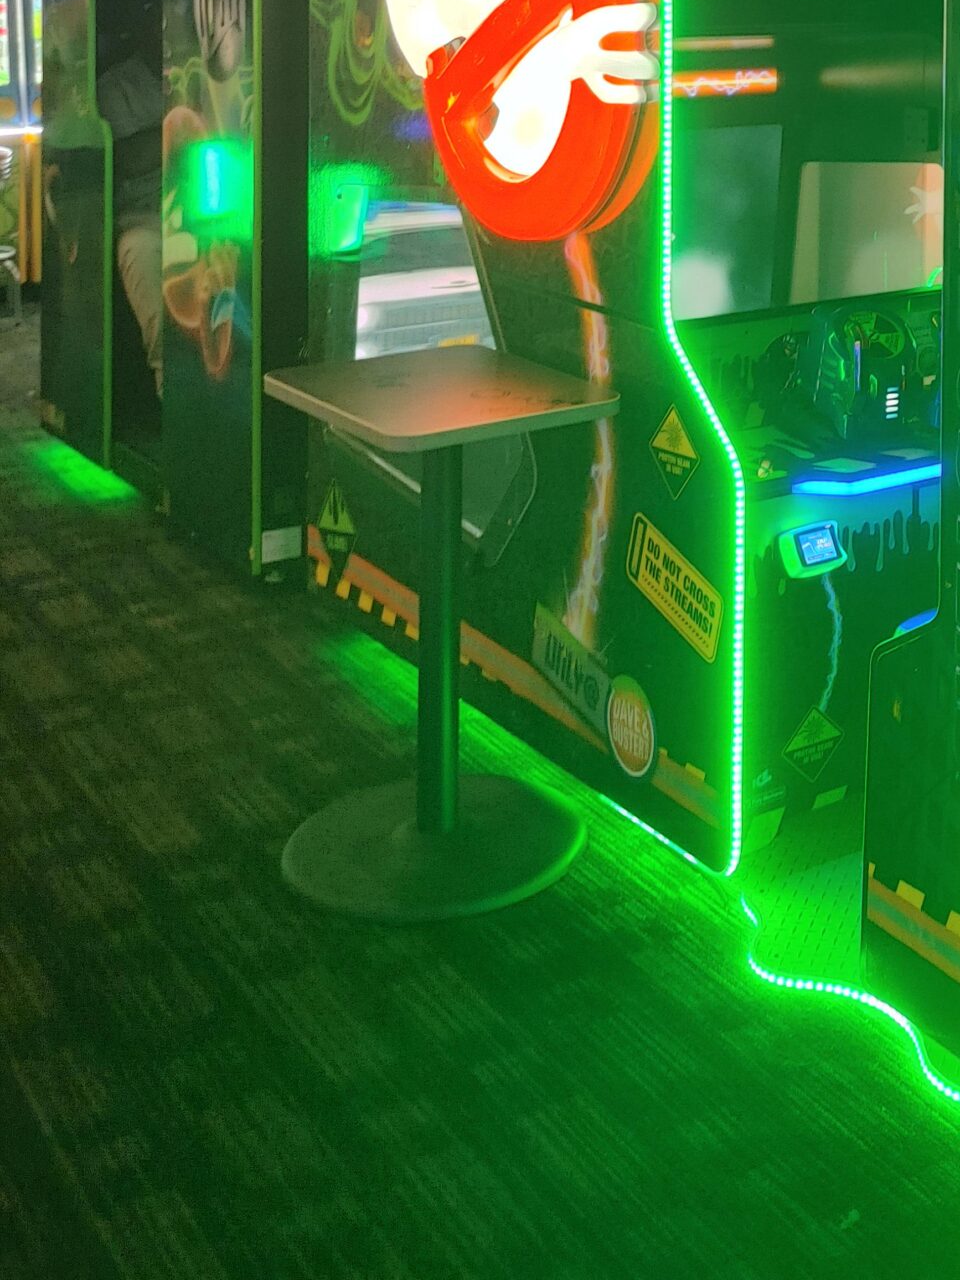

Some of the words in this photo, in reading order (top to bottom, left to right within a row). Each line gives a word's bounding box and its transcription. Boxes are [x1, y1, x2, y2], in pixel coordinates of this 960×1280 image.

[645, 554, 662, 585] THE
[663, 575, 713, 638] STREAMS!
[647, 537, 660, 561] DO
[662, 551, 682, 582] NOT
[682, 574, 716, 619] CROSS
[612, 696, 641, 734] DAVE
